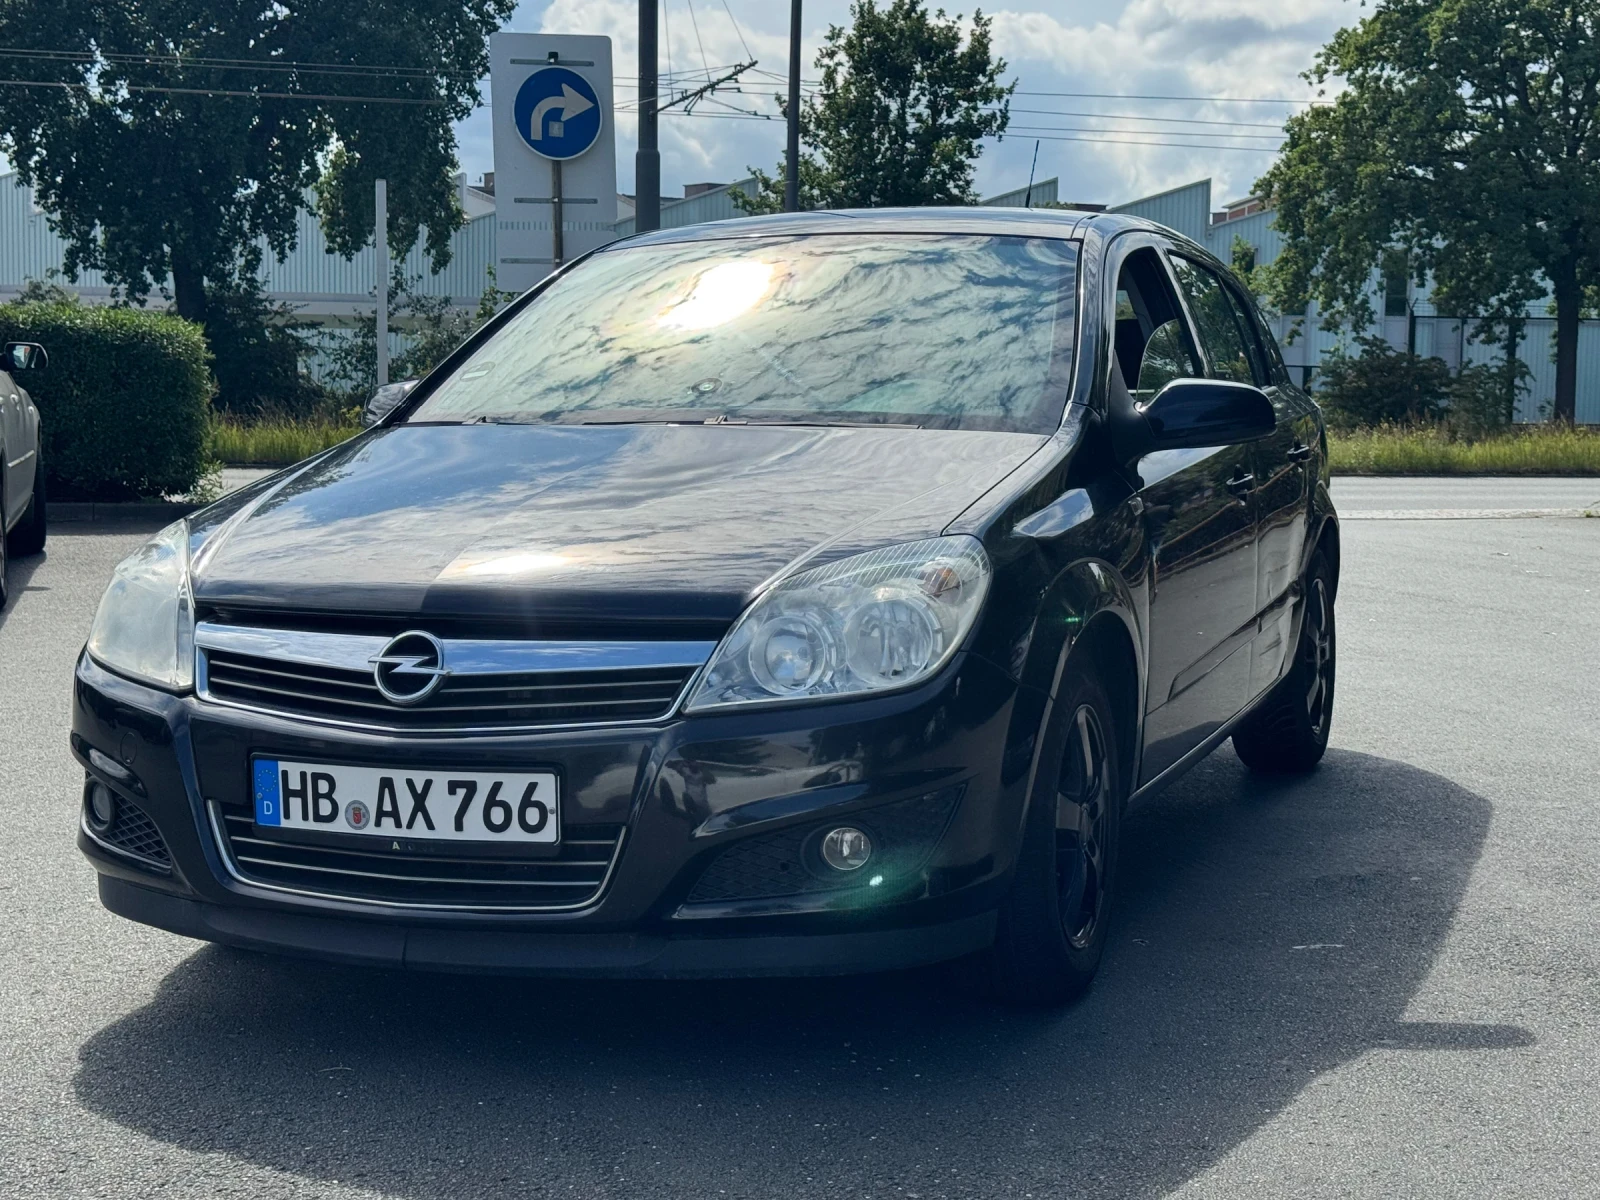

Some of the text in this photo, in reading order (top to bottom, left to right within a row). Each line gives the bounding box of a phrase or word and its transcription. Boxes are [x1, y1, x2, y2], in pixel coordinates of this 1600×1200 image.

[263, 769, 548, 833] D HB AX 766
